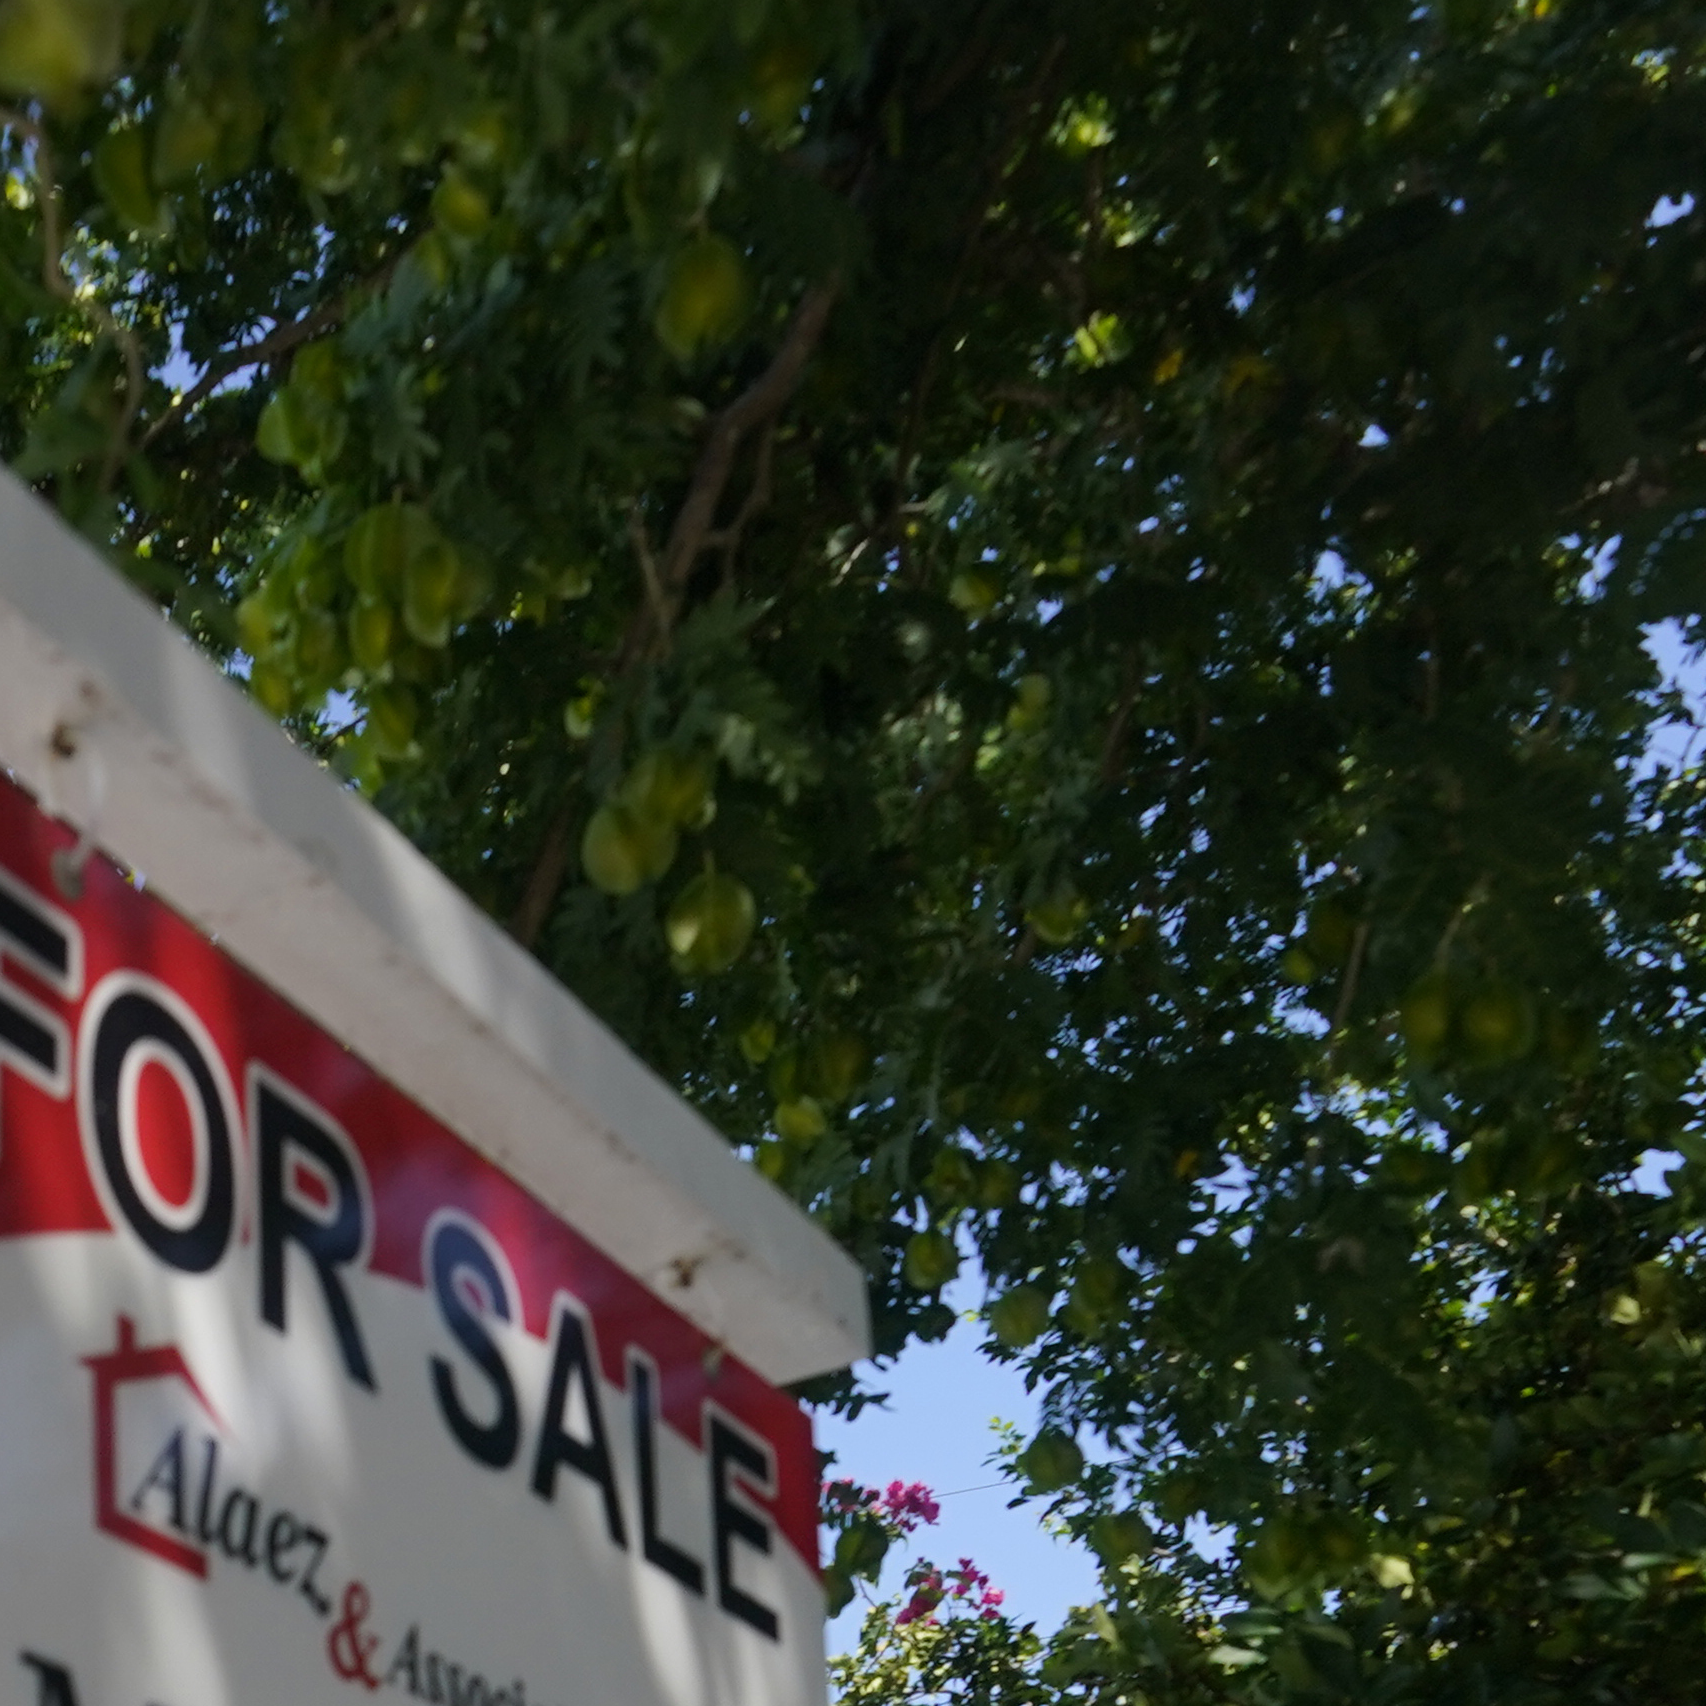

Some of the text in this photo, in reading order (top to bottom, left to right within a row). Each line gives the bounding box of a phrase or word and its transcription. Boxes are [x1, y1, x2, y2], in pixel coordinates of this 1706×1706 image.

[131, 1427, 333, 1618] Alaez
[326, 1581, 379, 1693] &
[421, 1208, 781, 1642] SALE
